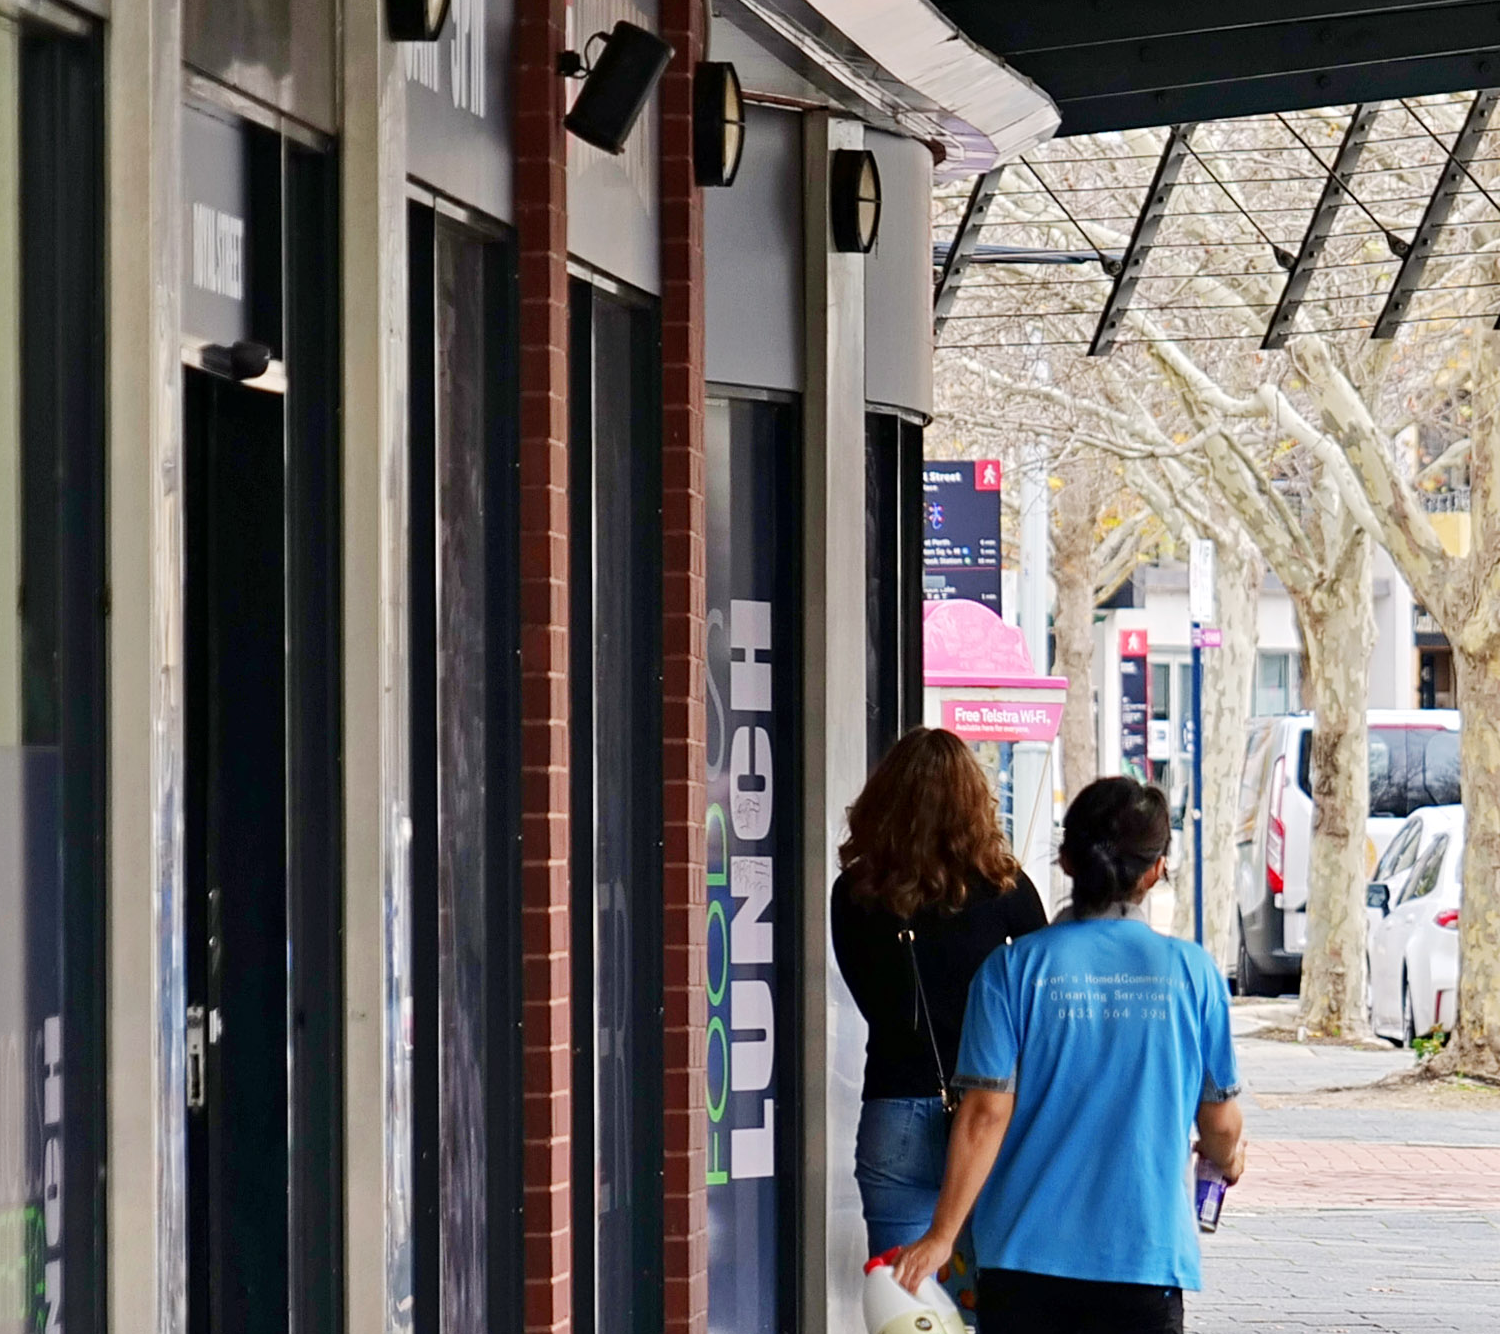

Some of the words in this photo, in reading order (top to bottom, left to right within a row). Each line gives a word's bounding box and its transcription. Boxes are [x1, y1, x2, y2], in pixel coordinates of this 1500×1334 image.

[955, 707, 980, 723] Free
[980, 707, 1020, 724] Telstra
[730, 599, 775, 1179] LUNCH
[706, 801, 729, 1185] FOOD
[1050, 990, 1107, 1004] Cleaning
[1114, 989, 1172, 1003] Services
[1058, 1007, 1093, 1020] 0433
